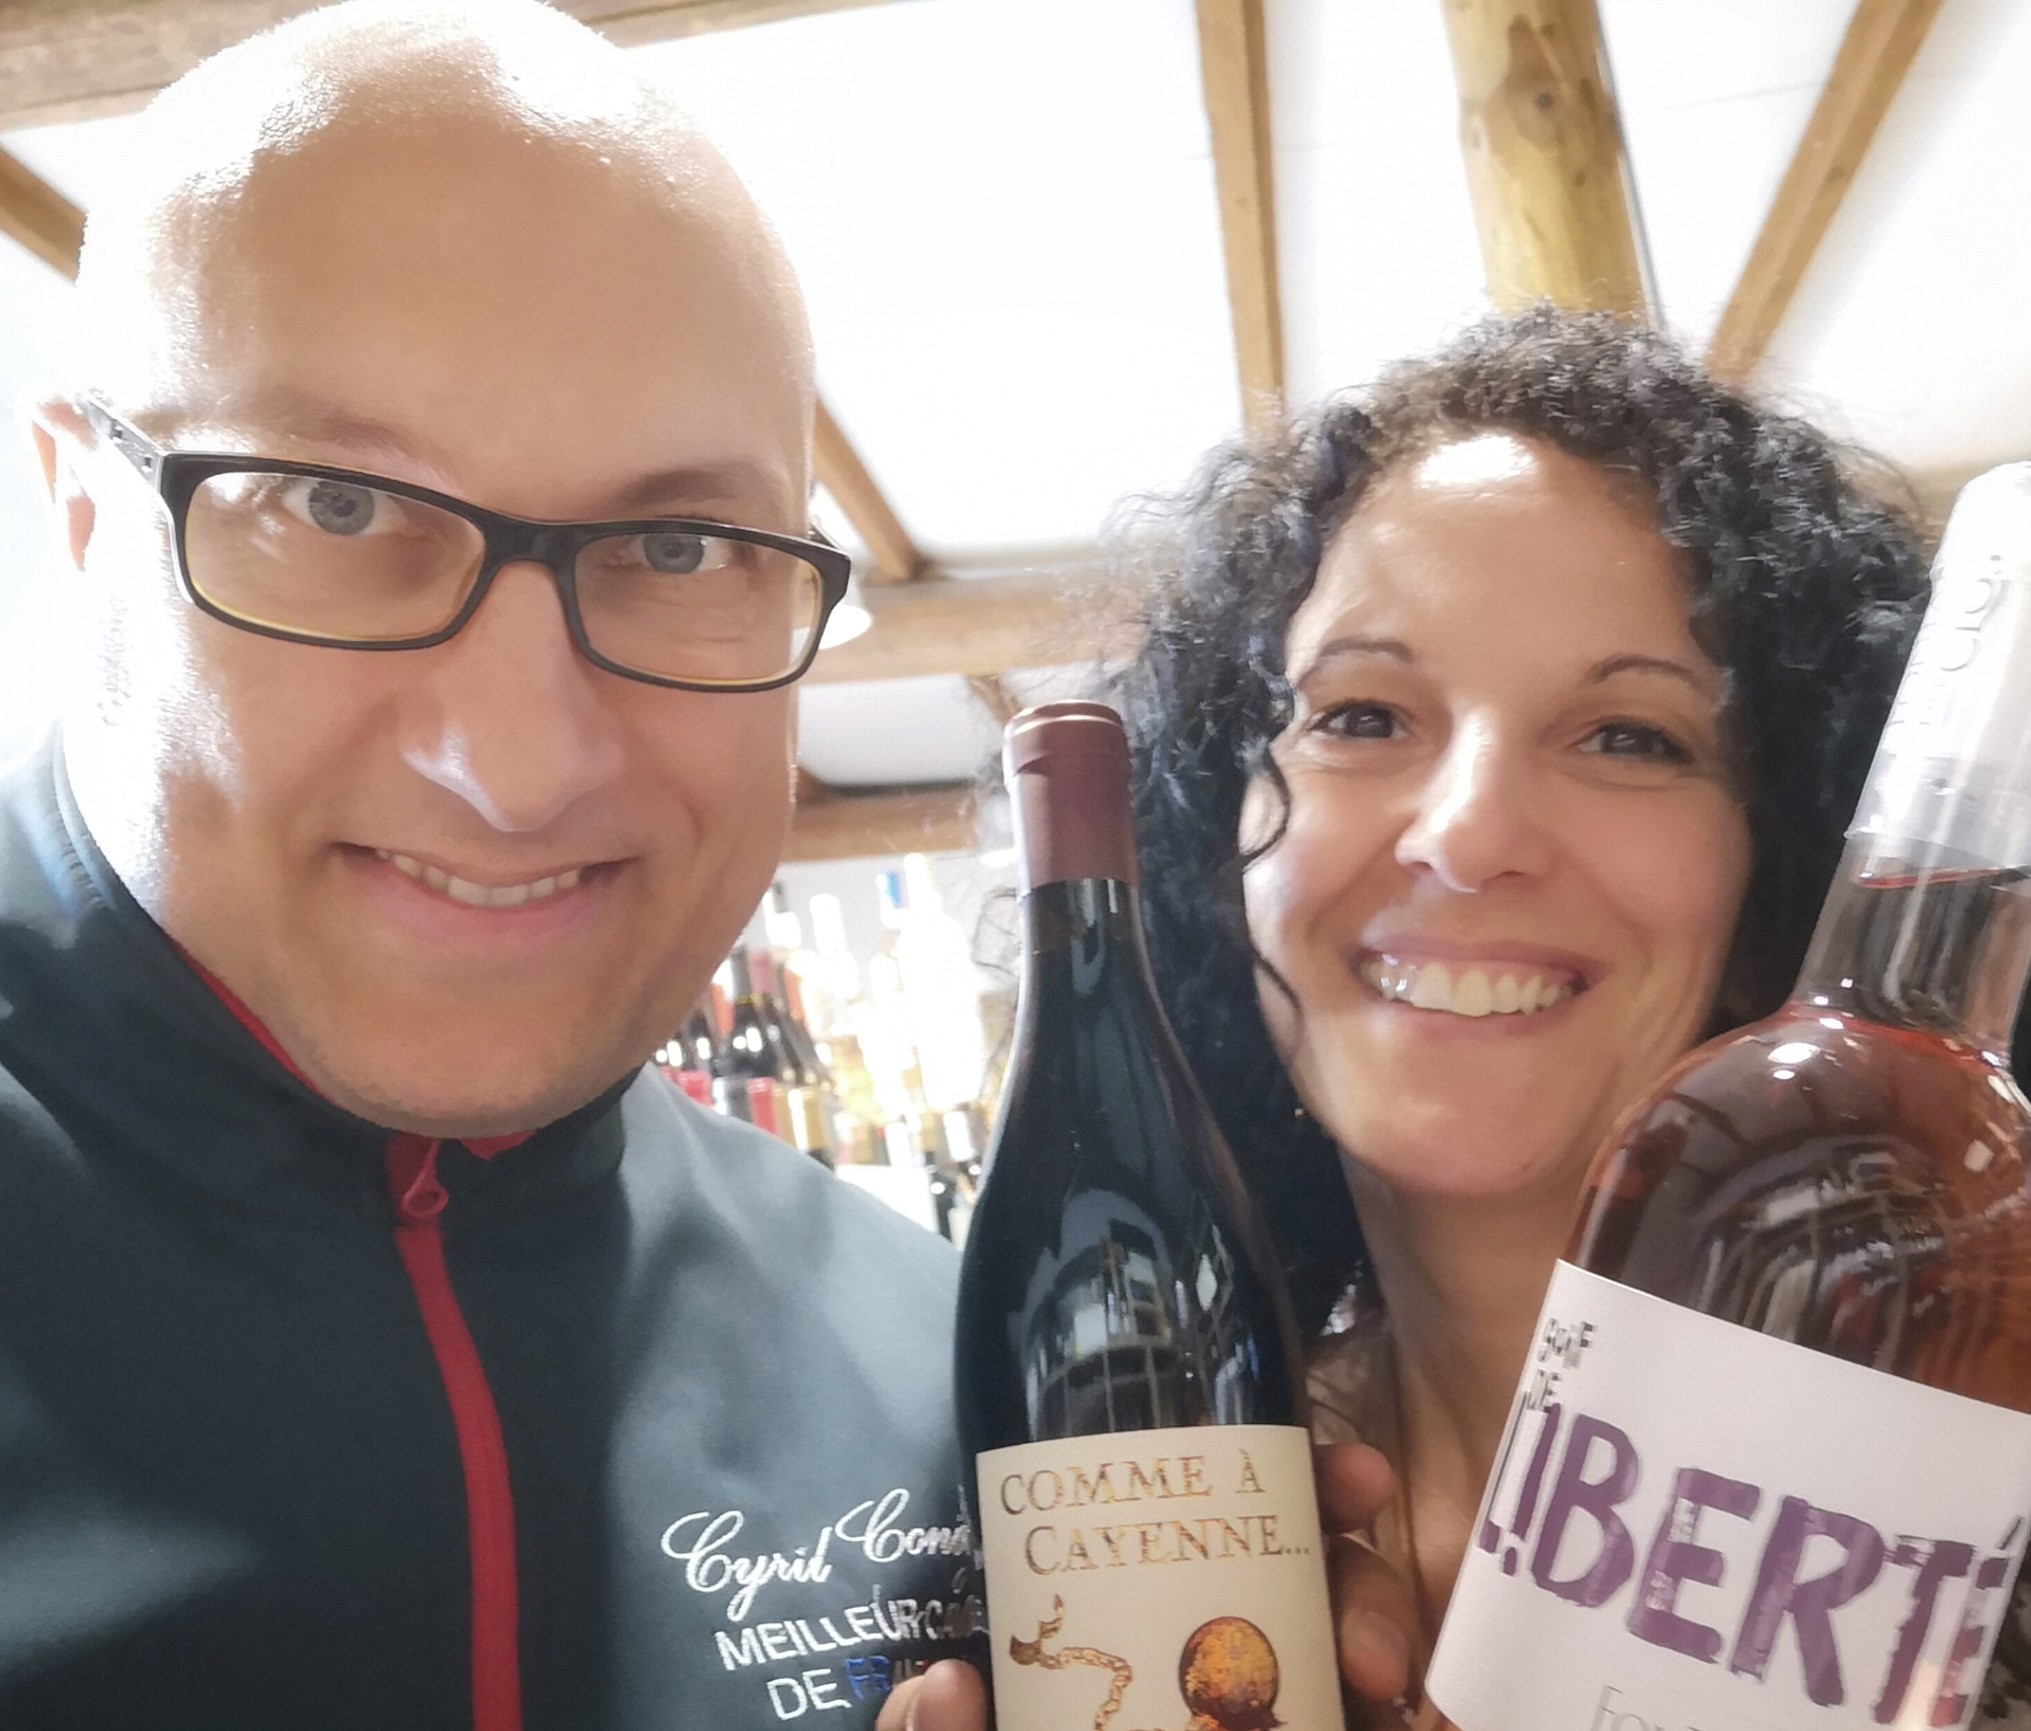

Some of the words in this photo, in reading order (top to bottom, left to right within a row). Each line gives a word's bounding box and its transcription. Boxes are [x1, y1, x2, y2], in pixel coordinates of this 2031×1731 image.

[1000, 1455, 1212, 1515] COMME
[1234, 1448, 1265, 1494] À
[660, 1510, 833, 1622] Cyril
[1024, 1514, 1309, 1576] CAYENNE...
[713, 1597, 921, 1672] MEILLEUR
[766, 1668, 852, 1721] DE
